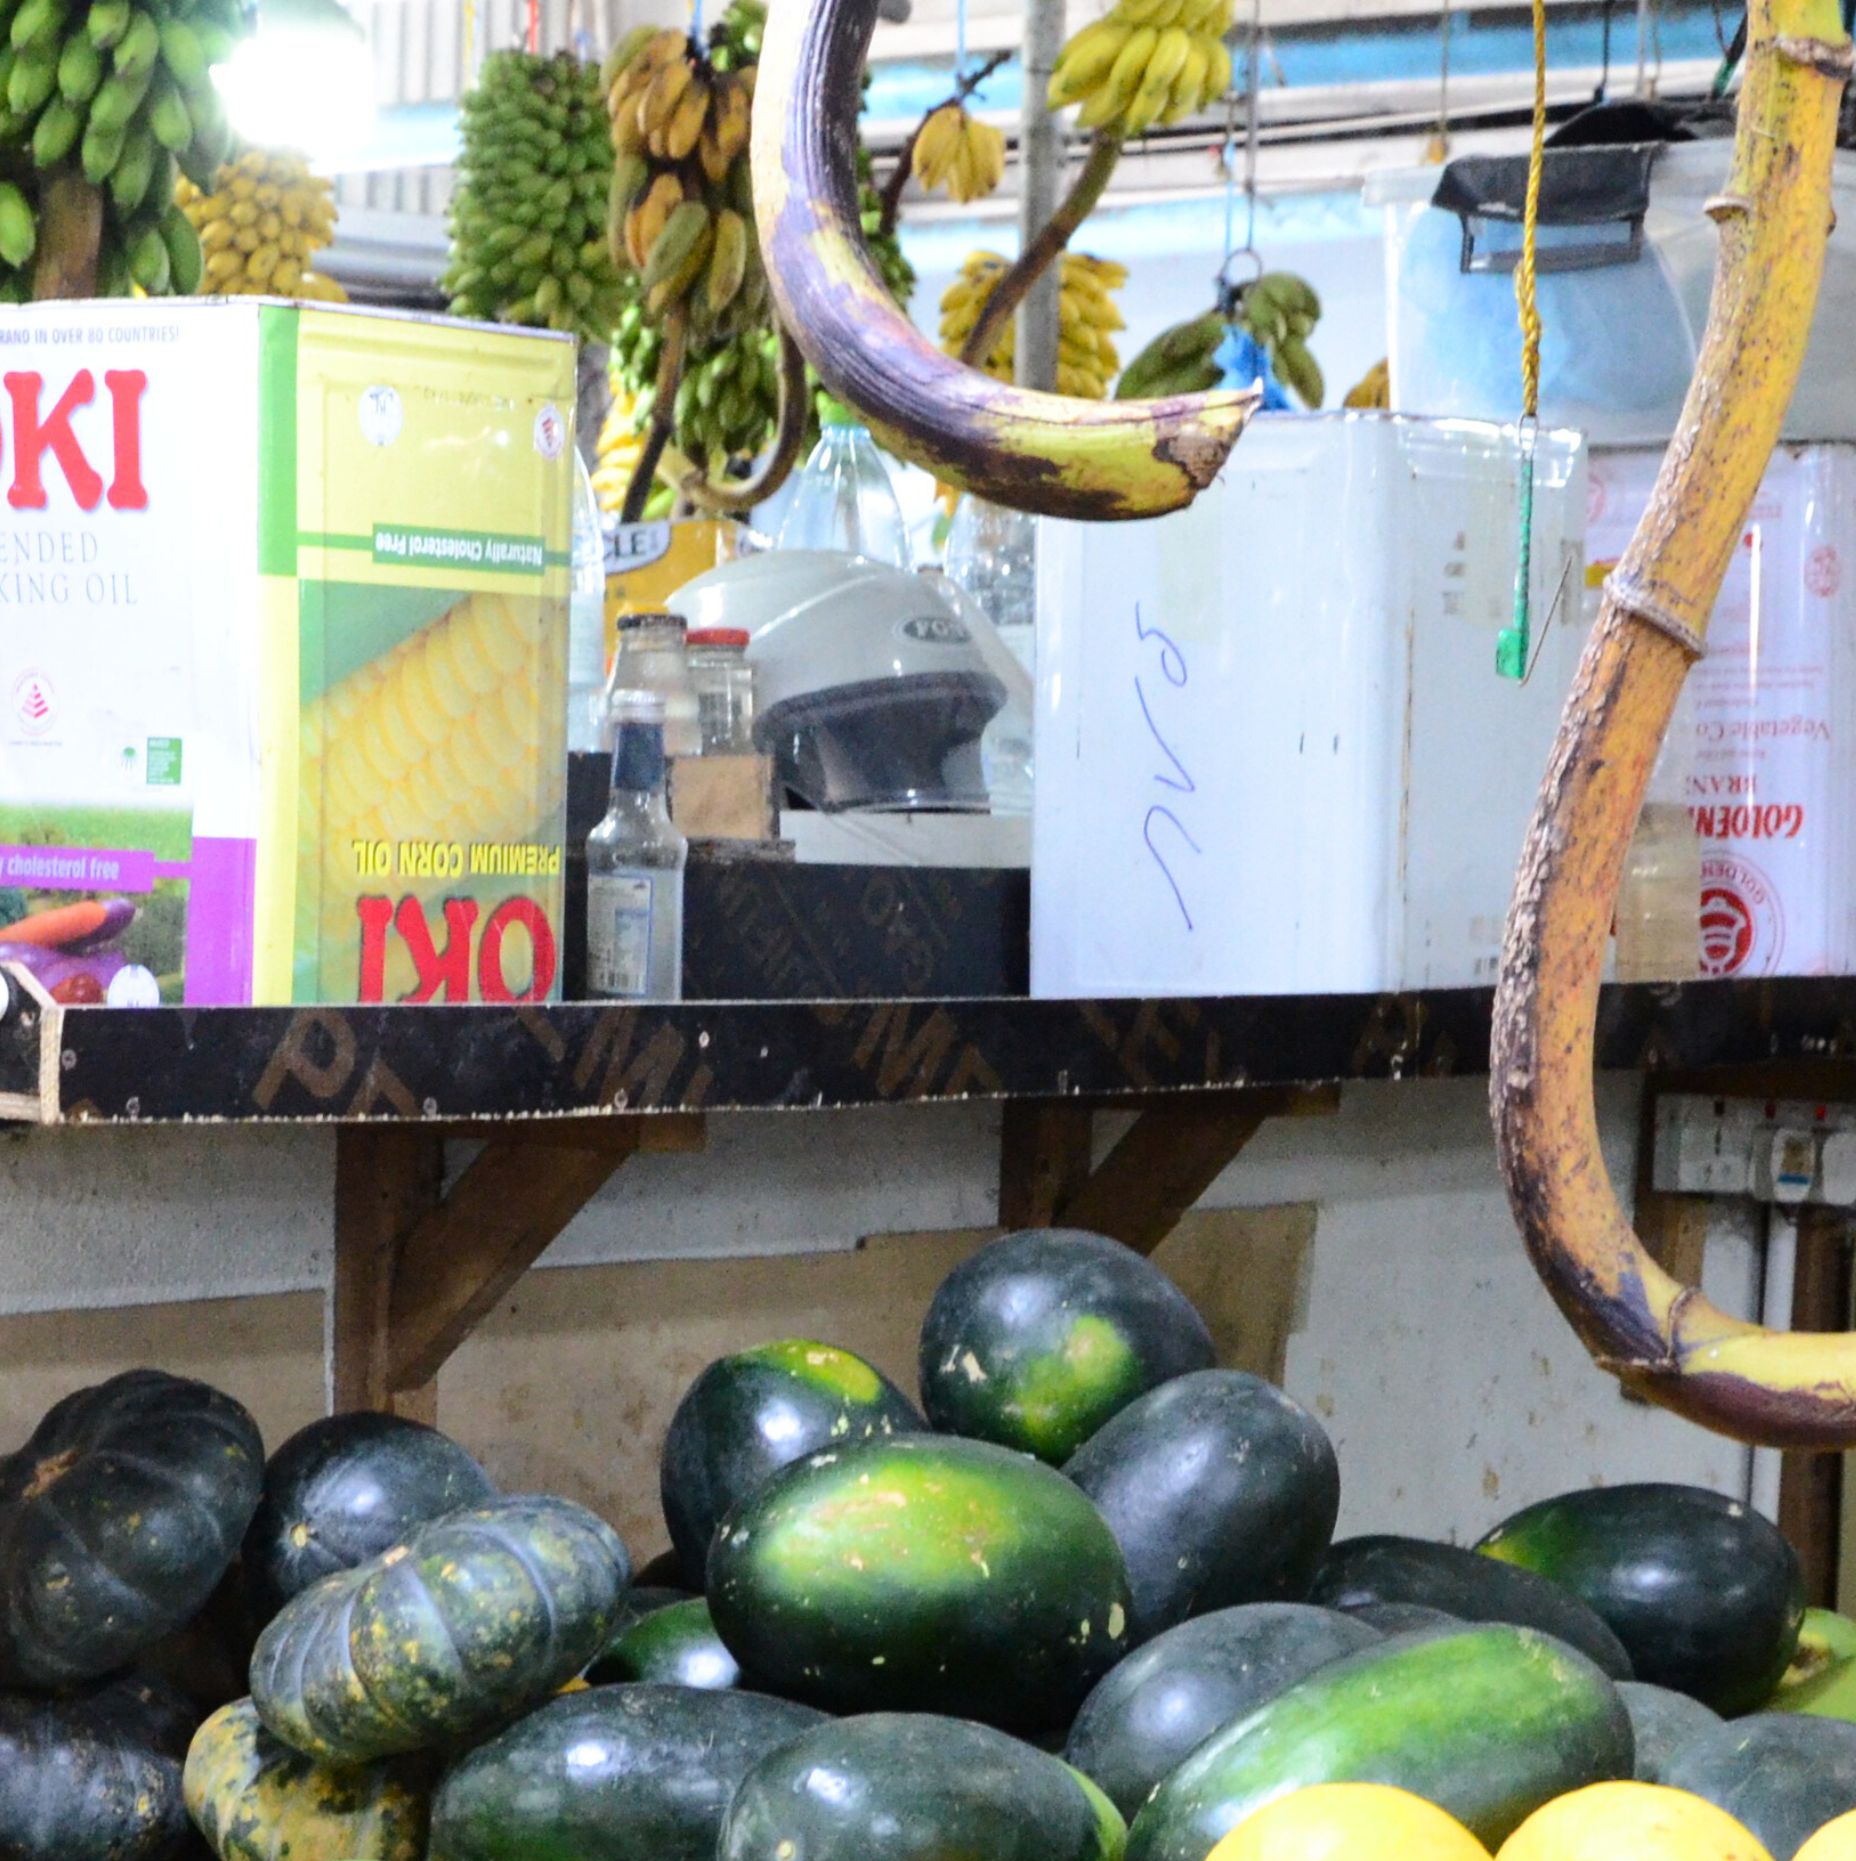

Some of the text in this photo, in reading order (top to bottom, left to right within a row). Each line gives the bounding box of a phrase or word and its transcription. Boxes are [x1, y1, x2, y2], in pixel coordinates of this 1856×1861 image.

[34, 327, 48, 344] IN
[52, 326, 83, 344] OVER
[87, 326, 104, 343] 80
[108, 325, 180, 343] COUNTRIES!
[375, 532, 543, 566] Naturally Cholesterol Free
[85, 573, 139, 604] OIL
[1729, 715, 1829, 741] Vegetable
[1685, 776, 1757, 796] BRAN
[1687, 803, 1804, 842] GOLDEN
[7, 854, 86, 880] cholesterol
[90, 857, 120, 880] free
[352, 839, 561, 878] PREMIUM CORN OIL
[356, 895, 556, 1003] OKI
